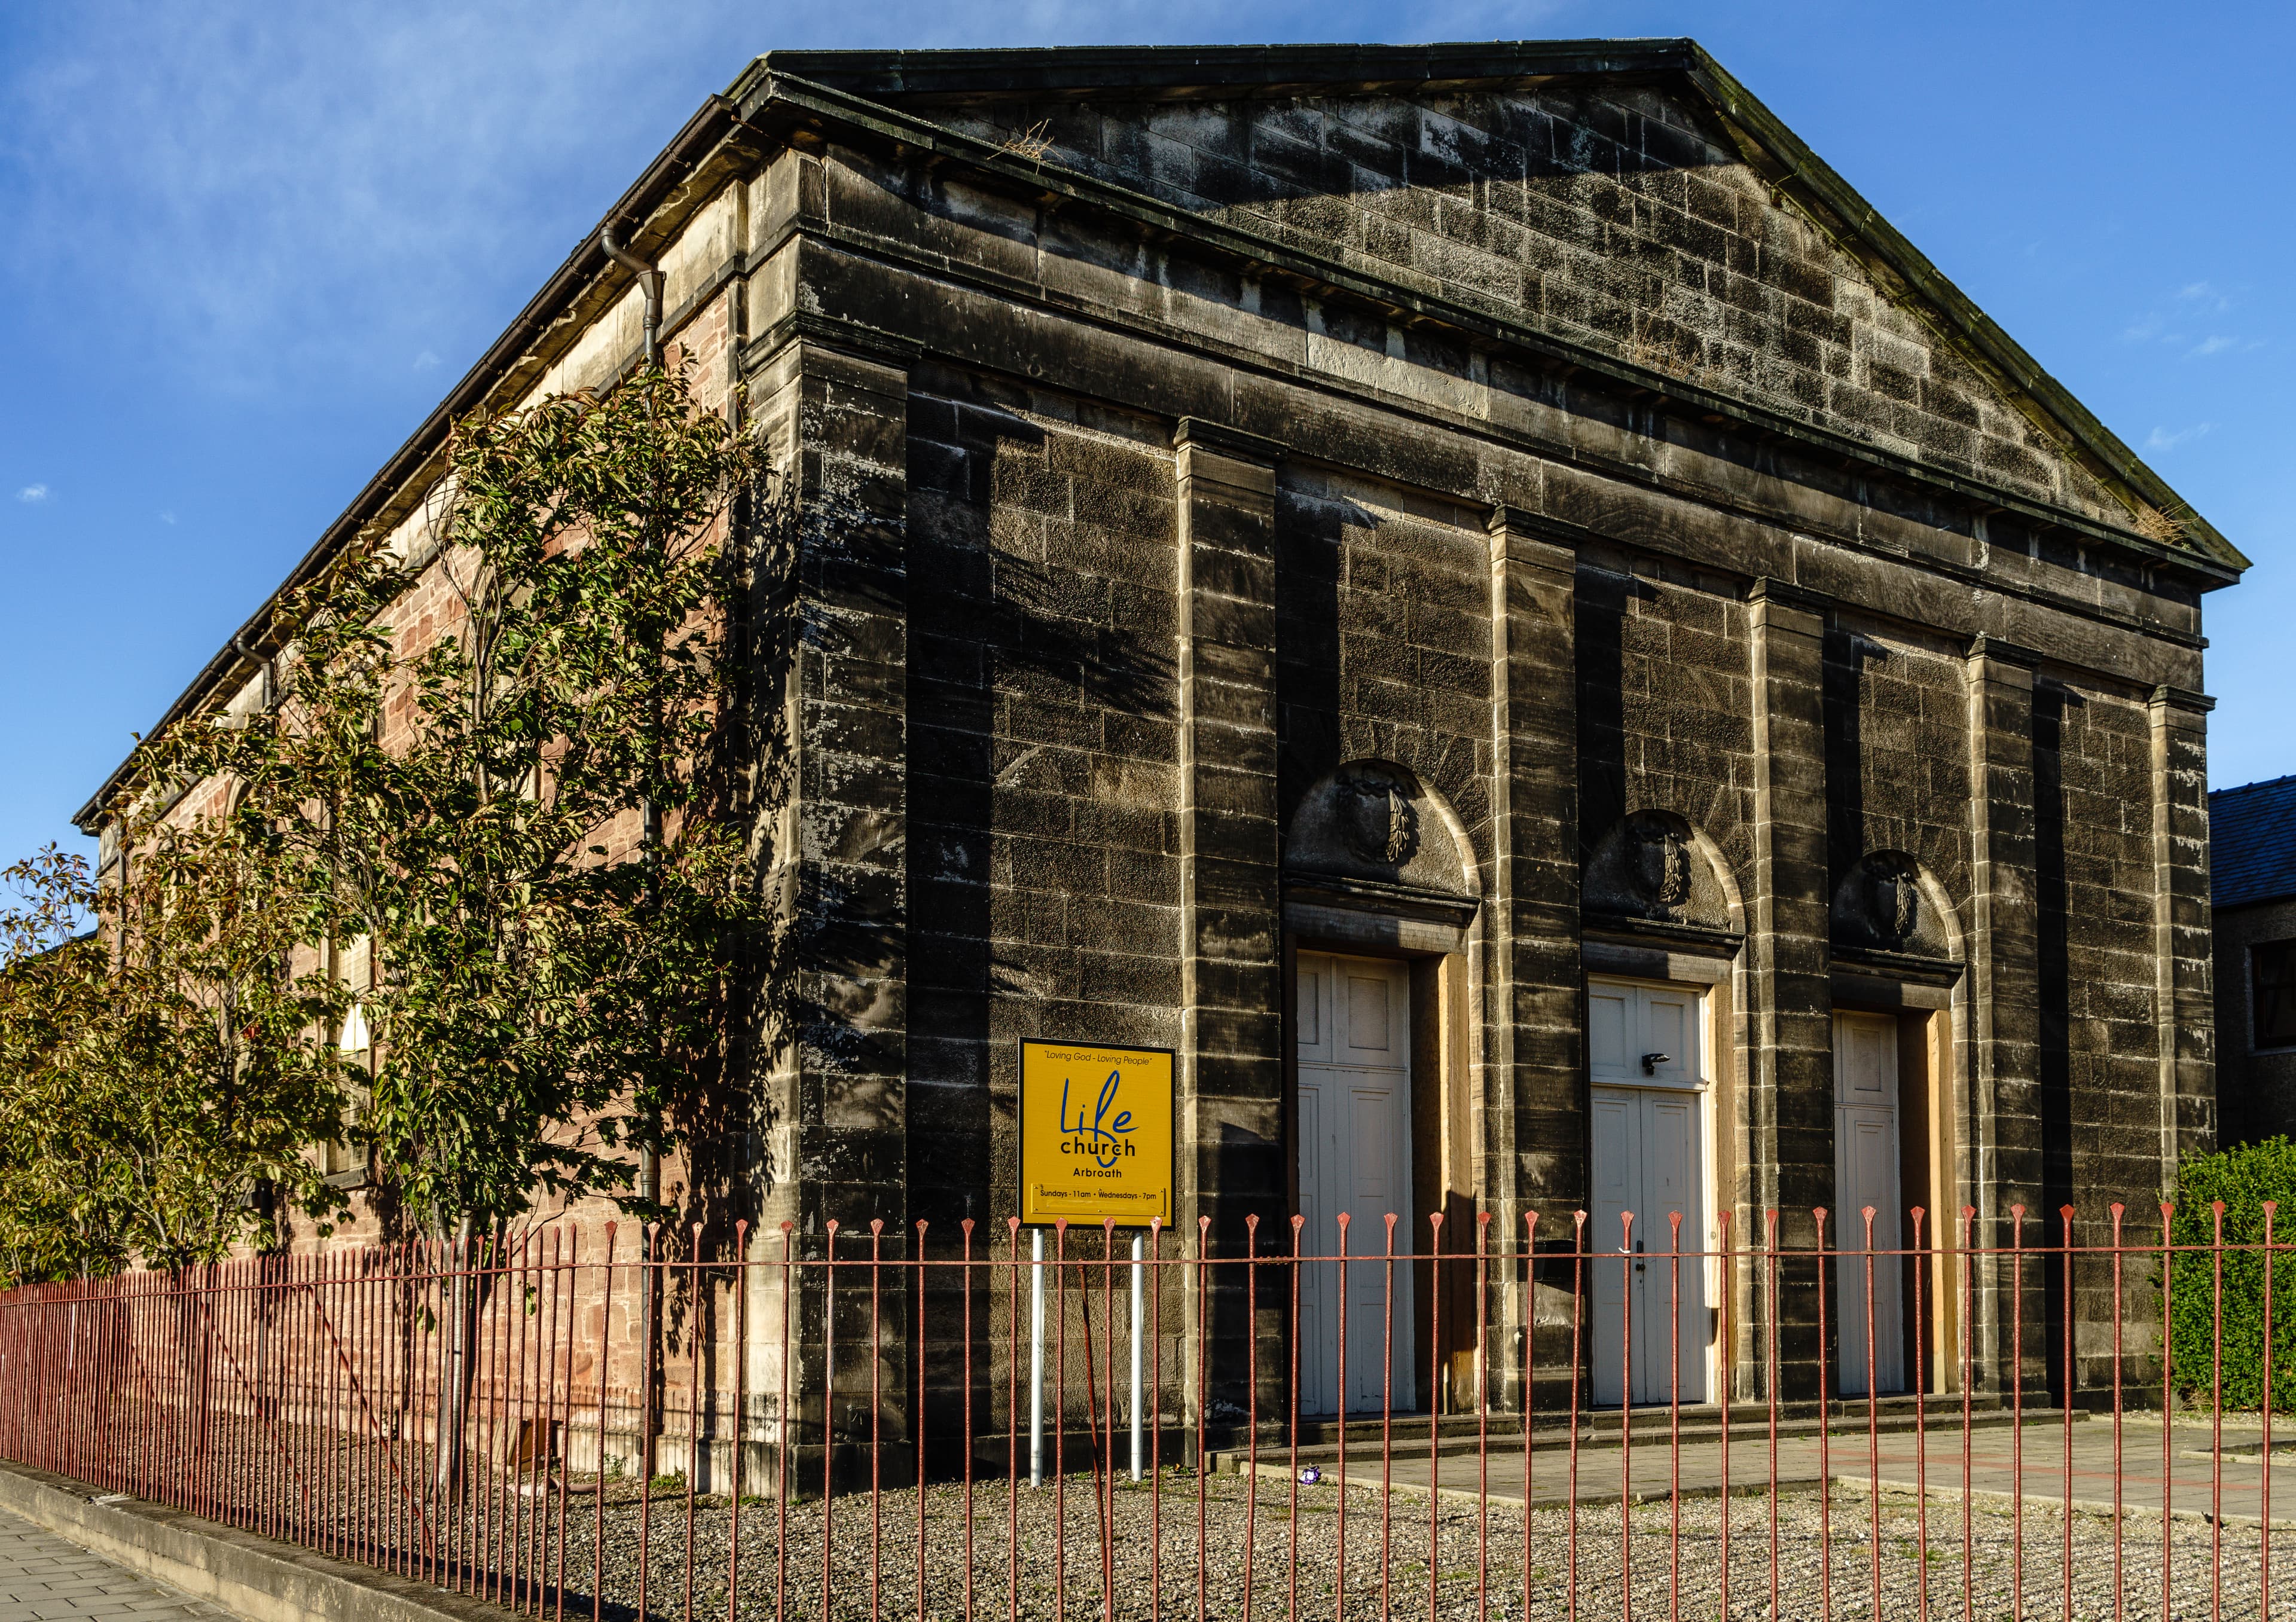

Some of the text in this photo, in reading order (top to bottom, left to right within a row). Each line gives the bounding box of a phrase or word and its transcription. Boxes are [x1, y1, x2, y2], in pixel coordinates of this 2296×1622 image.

[1074, 1052, 1091, 1061] God
[1097, 1054, 1121, 1065] Loving
[1061, 1070, 1138, 1168] Life
[1060, 1137, 1135, 1157] church
[1073, 1168, 1122, 1178] Arbroath
[1040, 1189, 1067, 1198] Sundays
[1098, 1192, 1138, 1200] Wednesdays
[1143, 1192, 1156, 1201] 7pm
